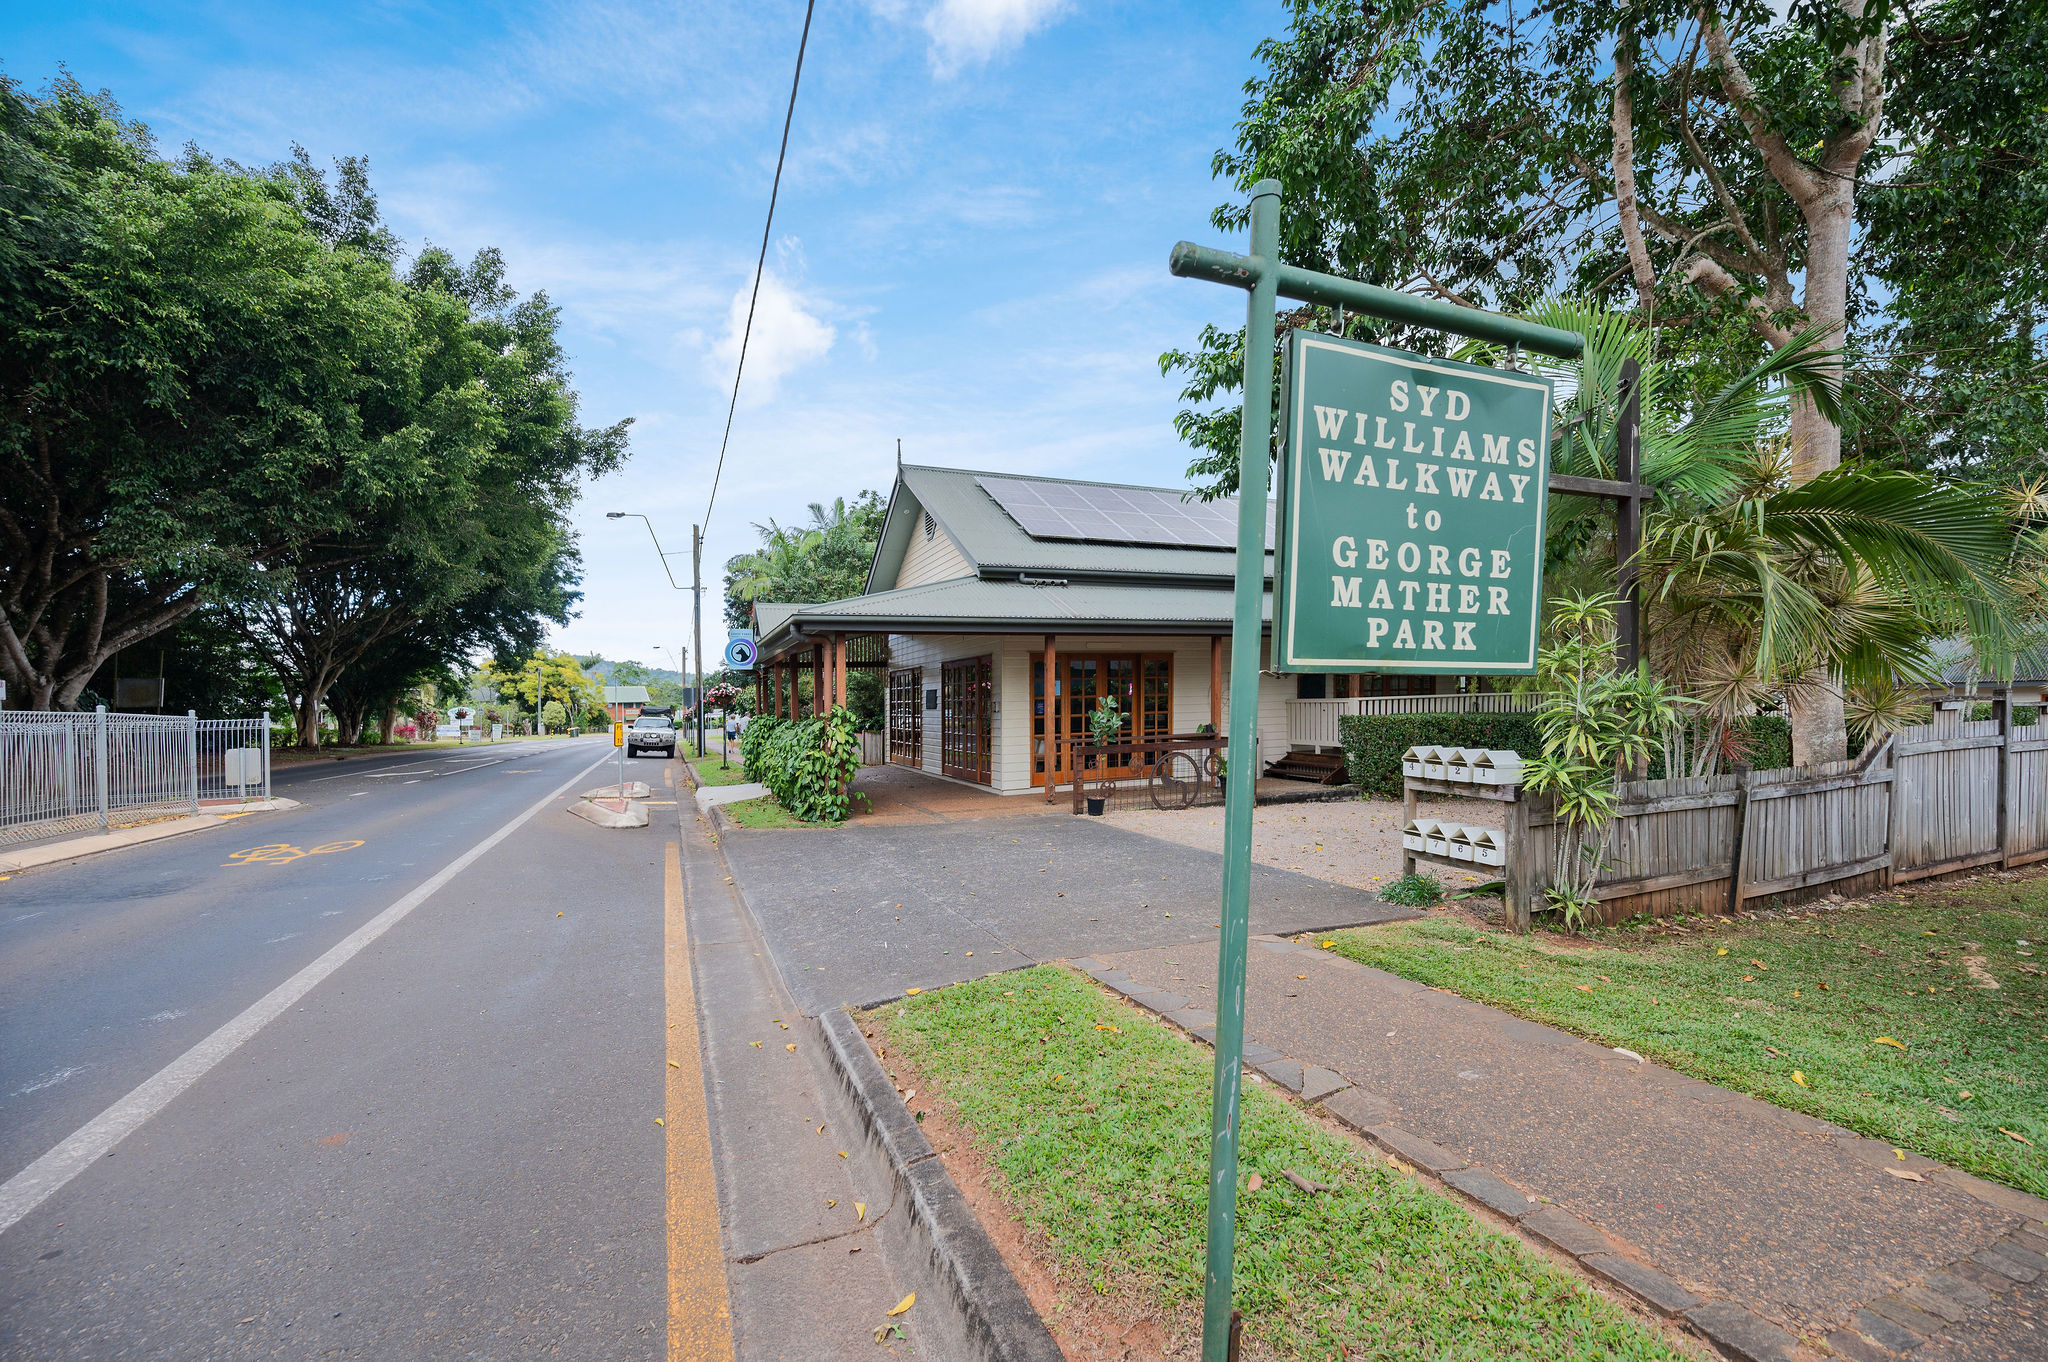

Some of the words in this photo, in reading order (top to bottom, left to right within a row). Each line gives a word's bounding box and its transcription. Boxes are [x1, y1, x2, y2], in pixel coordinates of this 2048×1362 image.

[1389, 379, 1471, 421] SYD
[1313, 404, 1536, 468] WILLIAMS
[1318, 447, 1531, 503] WALKWAY
[1406, 502, 1442, 531] to
[1332, 536, 1511, 579] GEORGE
[1330, 575, 1510, 615] MATHER
[1366, 617, 1477, 651] PARK
[1408, 762, 1414, 770] 4
[1455, 766, 1460, 774] 2
[1482, 768, 1486, 777] 1
[1482, 849, 1488, 857] 5
